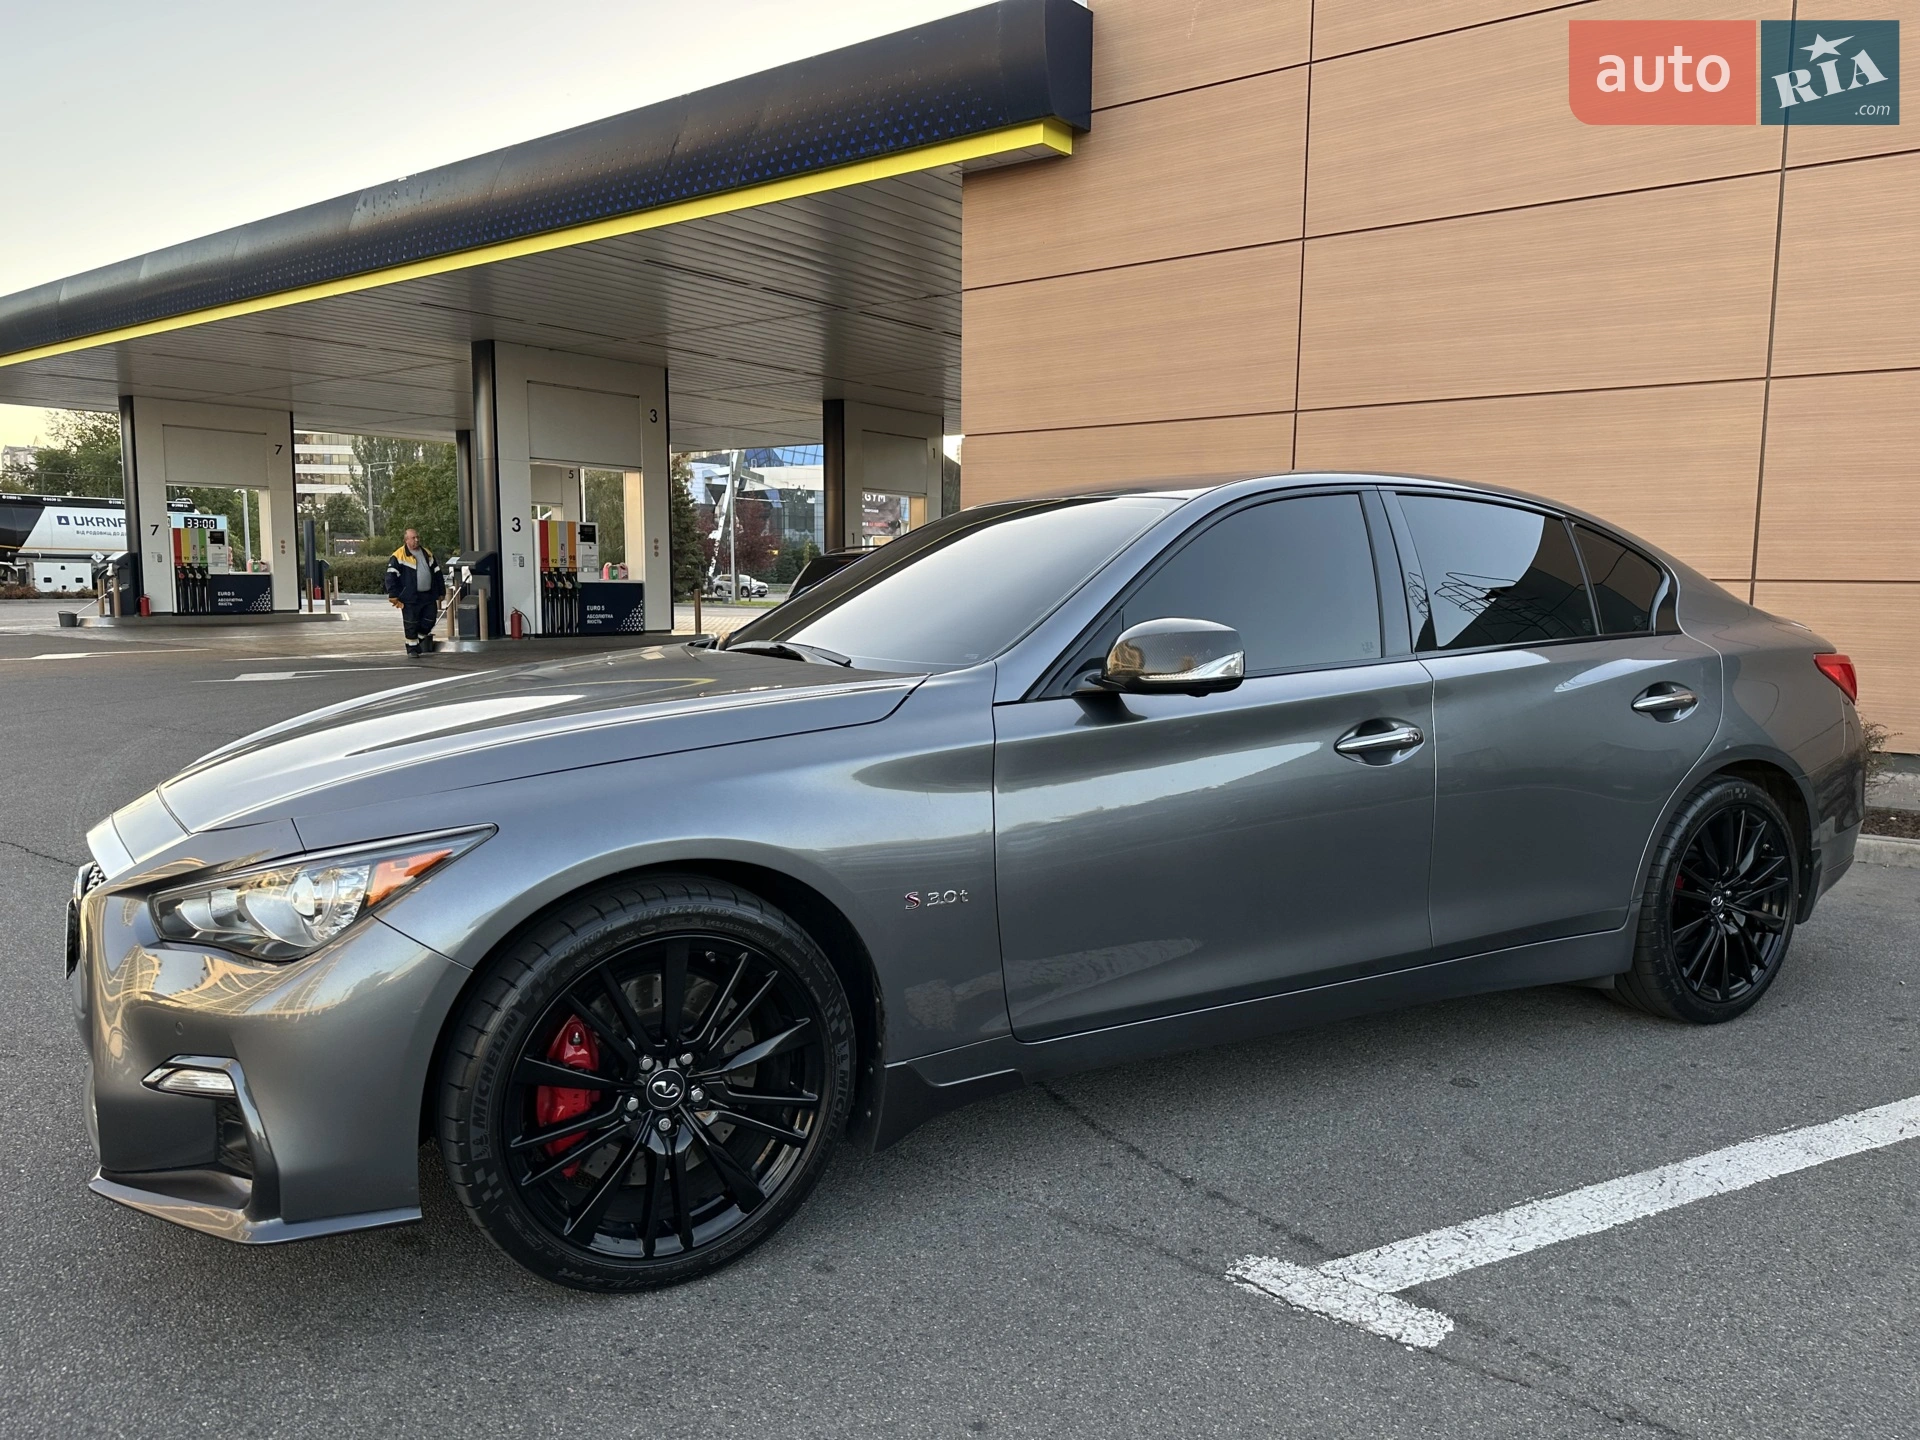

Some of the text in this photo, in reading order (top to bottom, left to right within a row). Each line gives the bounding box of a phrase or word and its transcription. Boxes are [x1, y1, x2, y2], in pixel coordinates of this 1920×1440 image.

[649, 408, 658, 423] 3
[275, 444, 283, 455] 7
[568, 470, 574, 479] 5
[150, 524, 160, 536] 7
[187, 518, 215, 529] 33:00
[511, 517, 521, 532] 3
[904, 889, 969, 910] S 3.0t
[471, 1010, 520, 1130] MICHELIN
